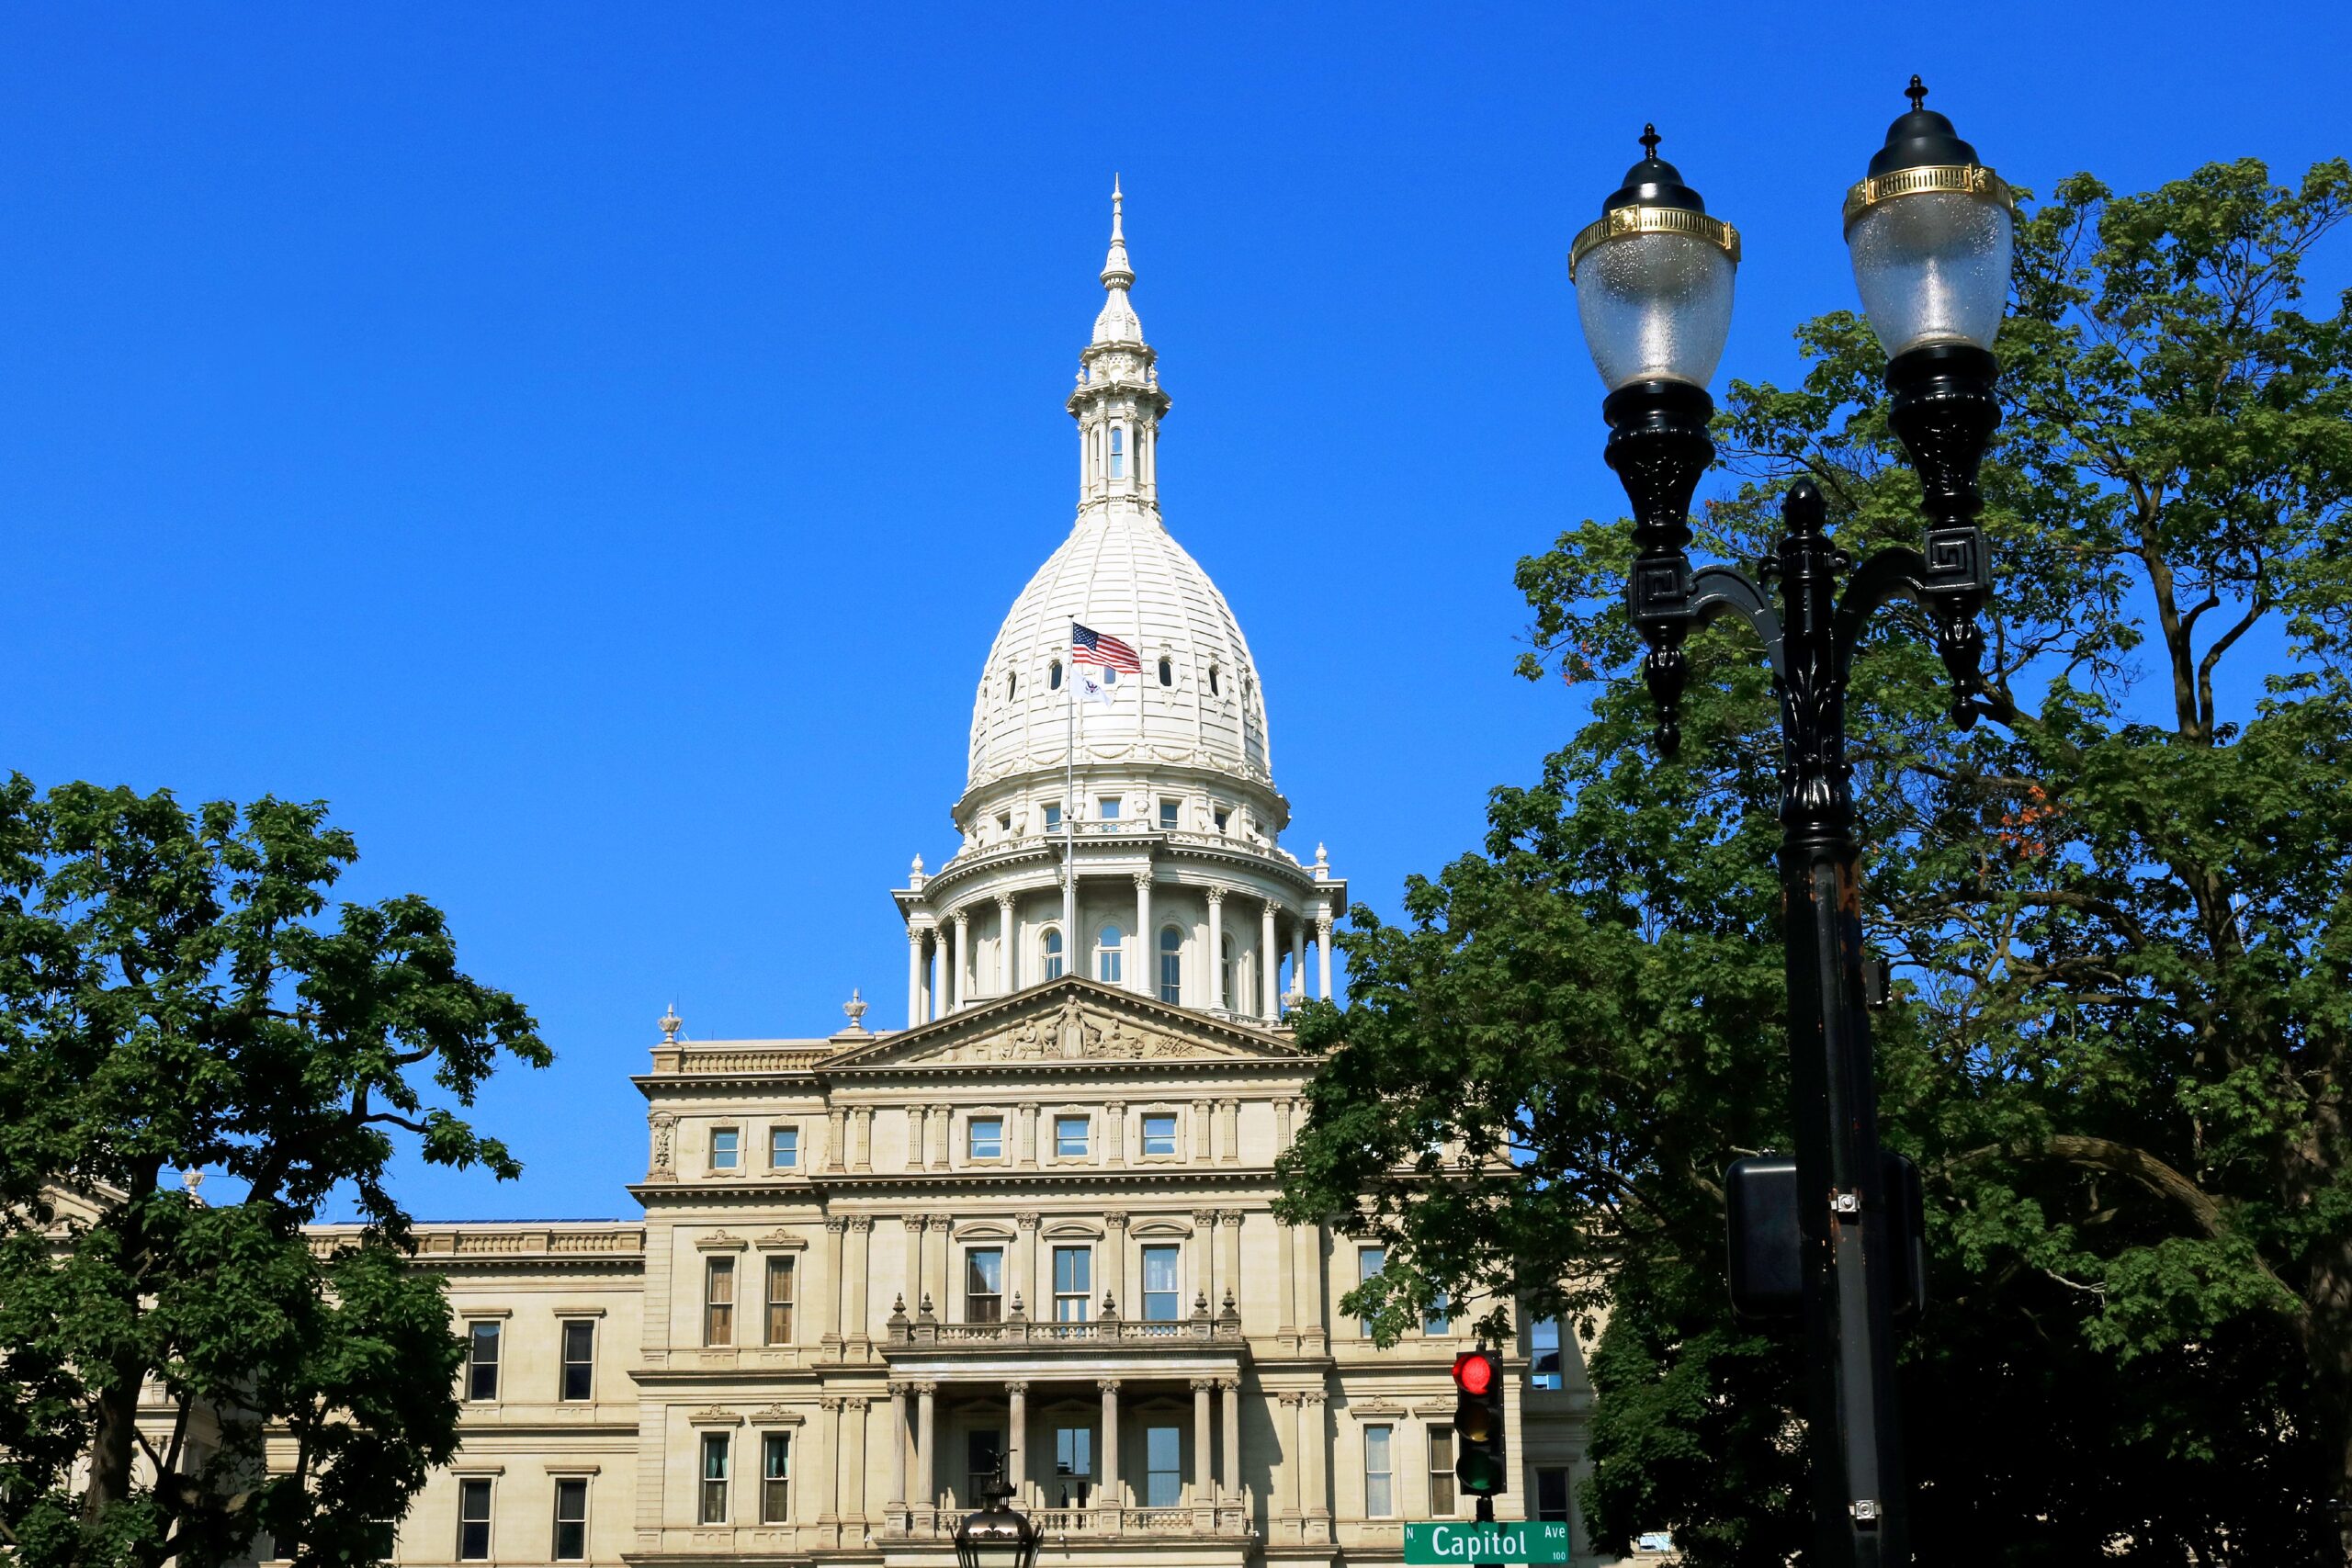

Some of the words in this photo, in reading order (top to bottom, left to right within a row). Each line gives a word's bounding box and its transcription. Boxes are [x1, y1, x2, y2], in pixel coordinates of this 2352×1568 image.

[1407, 1527, 1414, 1540] N
[1432, 1526, 1527, 1561] Capitol
[1544, 1526, 1566, 1539] Ave
[1553, 1551, 1566, 1561] 100
